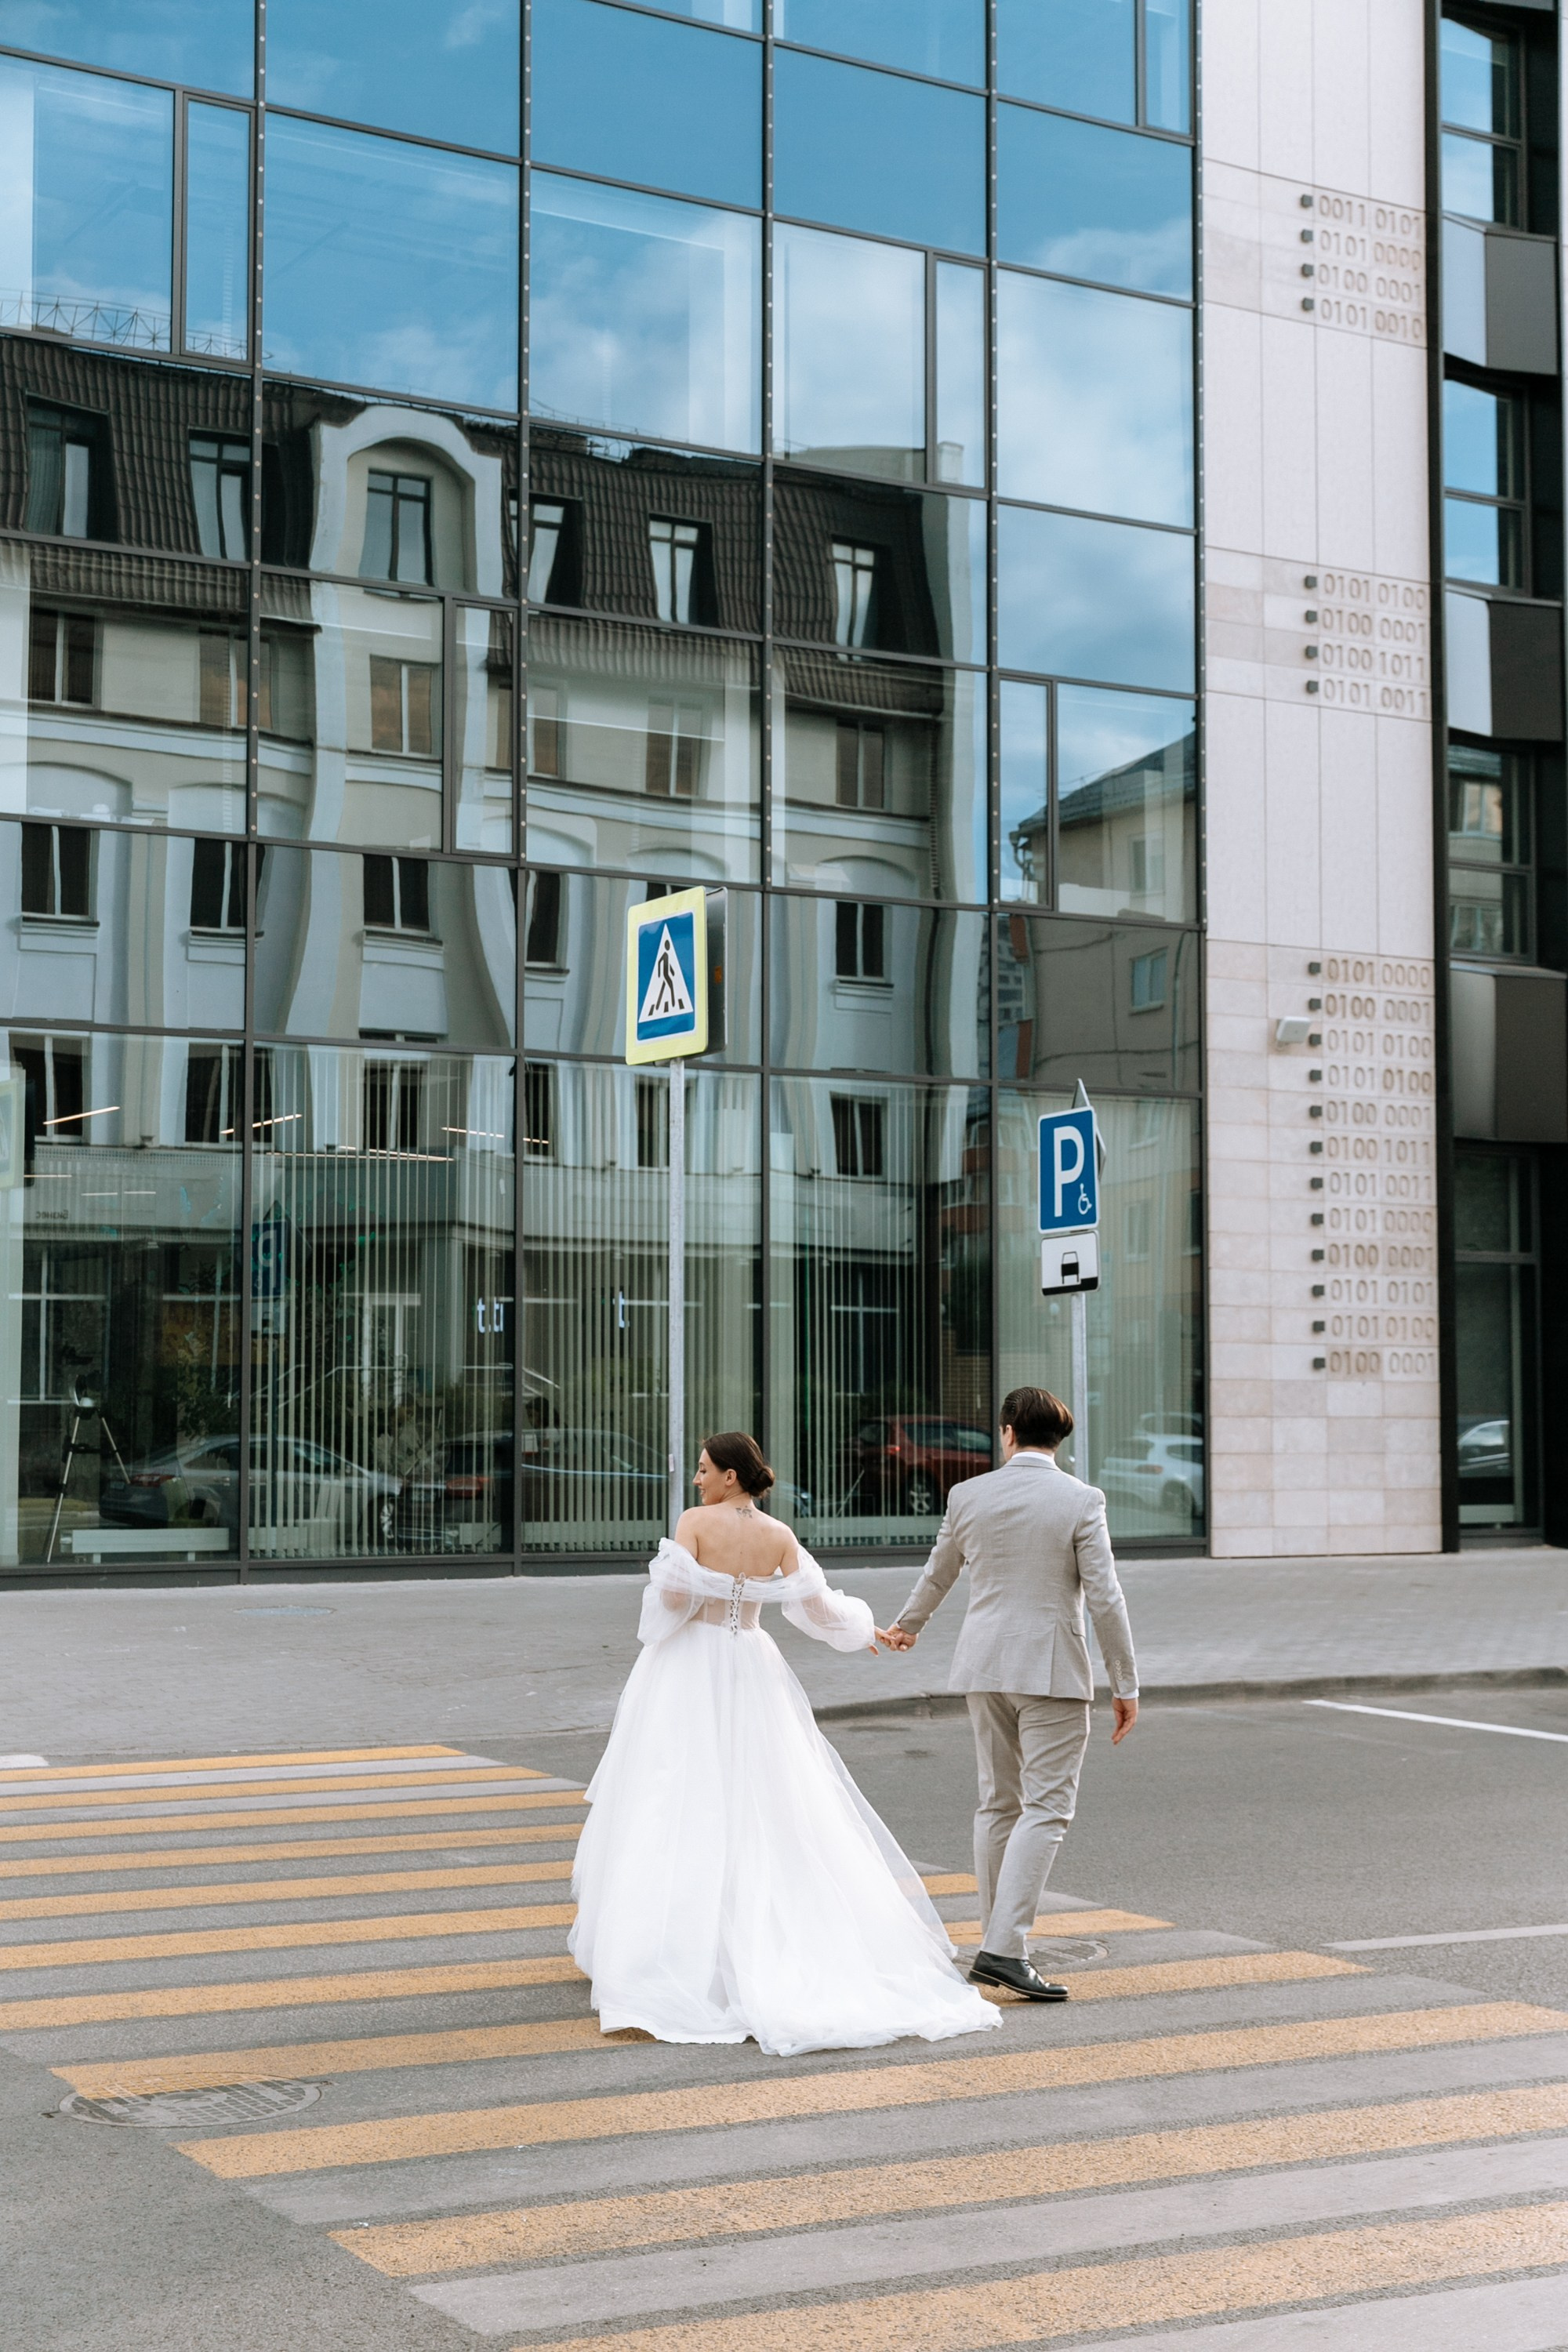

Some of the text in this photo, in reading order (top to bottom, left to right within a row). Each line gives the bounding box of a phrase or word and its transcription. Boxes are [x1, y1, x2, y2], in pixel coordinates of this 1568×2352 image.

[1319, 195, 1421, 238] 0011 0101
[1320, 230, 1421, 270] 0101 0000
[1319, 264, 1421, 306] 0100 0001
[1320, 299, 1422, 339] 0101 0010
[1324, 573, 1427, 610] 0101 0100
[1322, 608, 1426, 646] 0100 0001
[1322, 644, 1425, 680] 0100 1011
[1323, 678, 1427, 716] 0101 0011
[1327, 958, 1431, 988] 0101 0000
[1325, 993, 1430, 1025] 0100 0001
[1327, 1029, 1432, 1058] 0101 0100
[1328, 1065, 1433, 1093] 0101 0100
[1326, 1101, 1431, 1131] 0100 0001
[1327, 1136, 1429, 1164] 0100 1011
[1054, 1126, 1084, 1217] P
[1330, 1172, 1432, 1200] 0101 0011
[1330, 1207, 1433, 1233] 0101 0000
[1328, 1243, 1433, 1271] 0100 0001
[1330, 1279, 1433, 1305] 0101 0101
[1332, 1315, 1436, 1341] 0101 0100
[1330, 1351, 1435, 1376] 0100 0001
